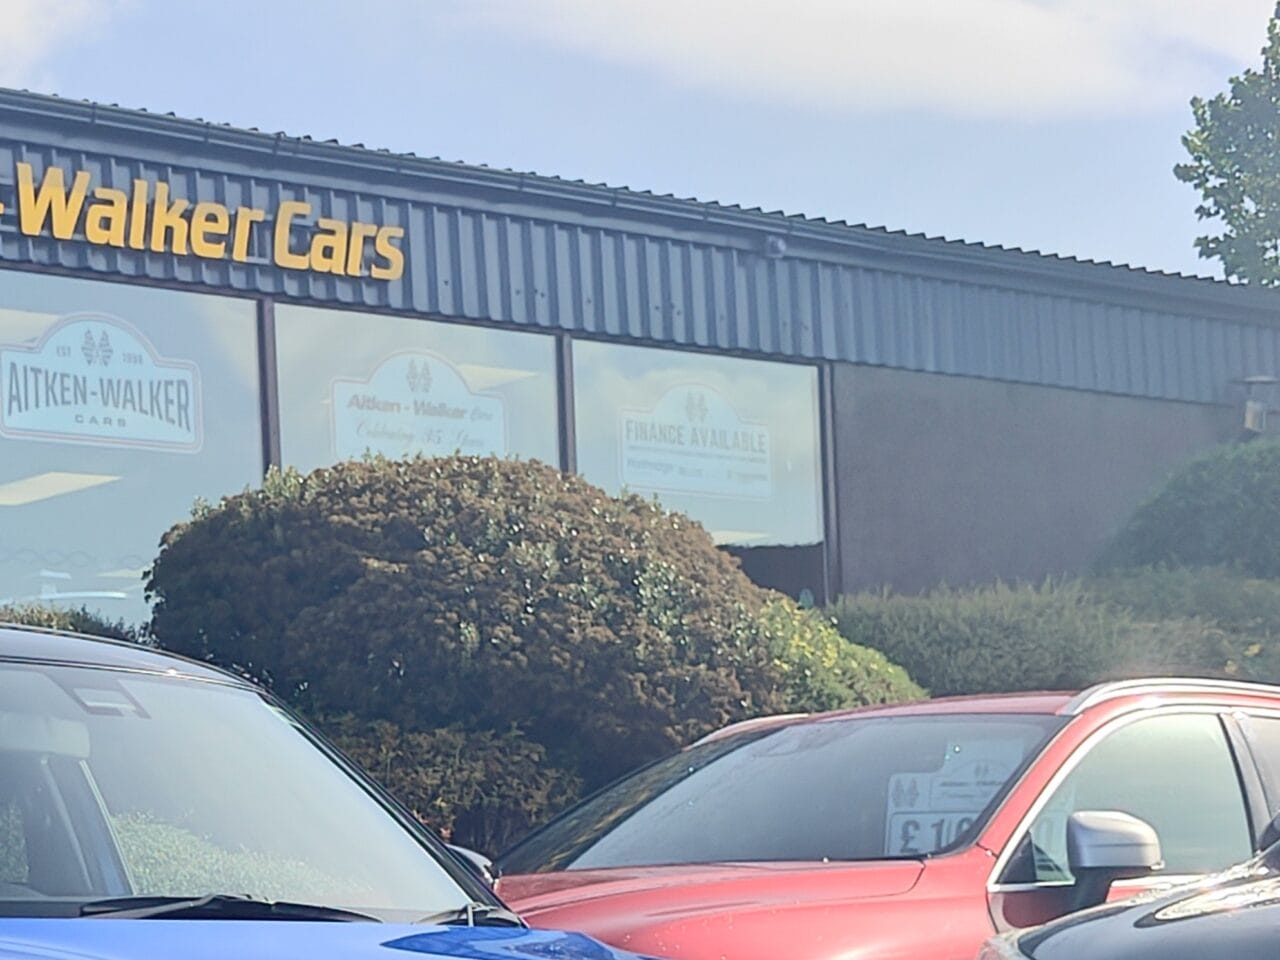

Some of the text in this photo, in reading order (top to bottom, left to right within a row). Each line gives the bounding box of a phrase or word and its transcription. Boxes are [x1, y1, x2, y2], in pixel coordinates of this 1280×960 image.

[17, 162, 265, 263] Walker
[273, 200, 405, 281] Cars
[7, 361, 192, 433] AITKEN-WALKER
[74, 413, 127, 428] CARS
[625, 419, 767, 455] FINANCE AVAILABLE
